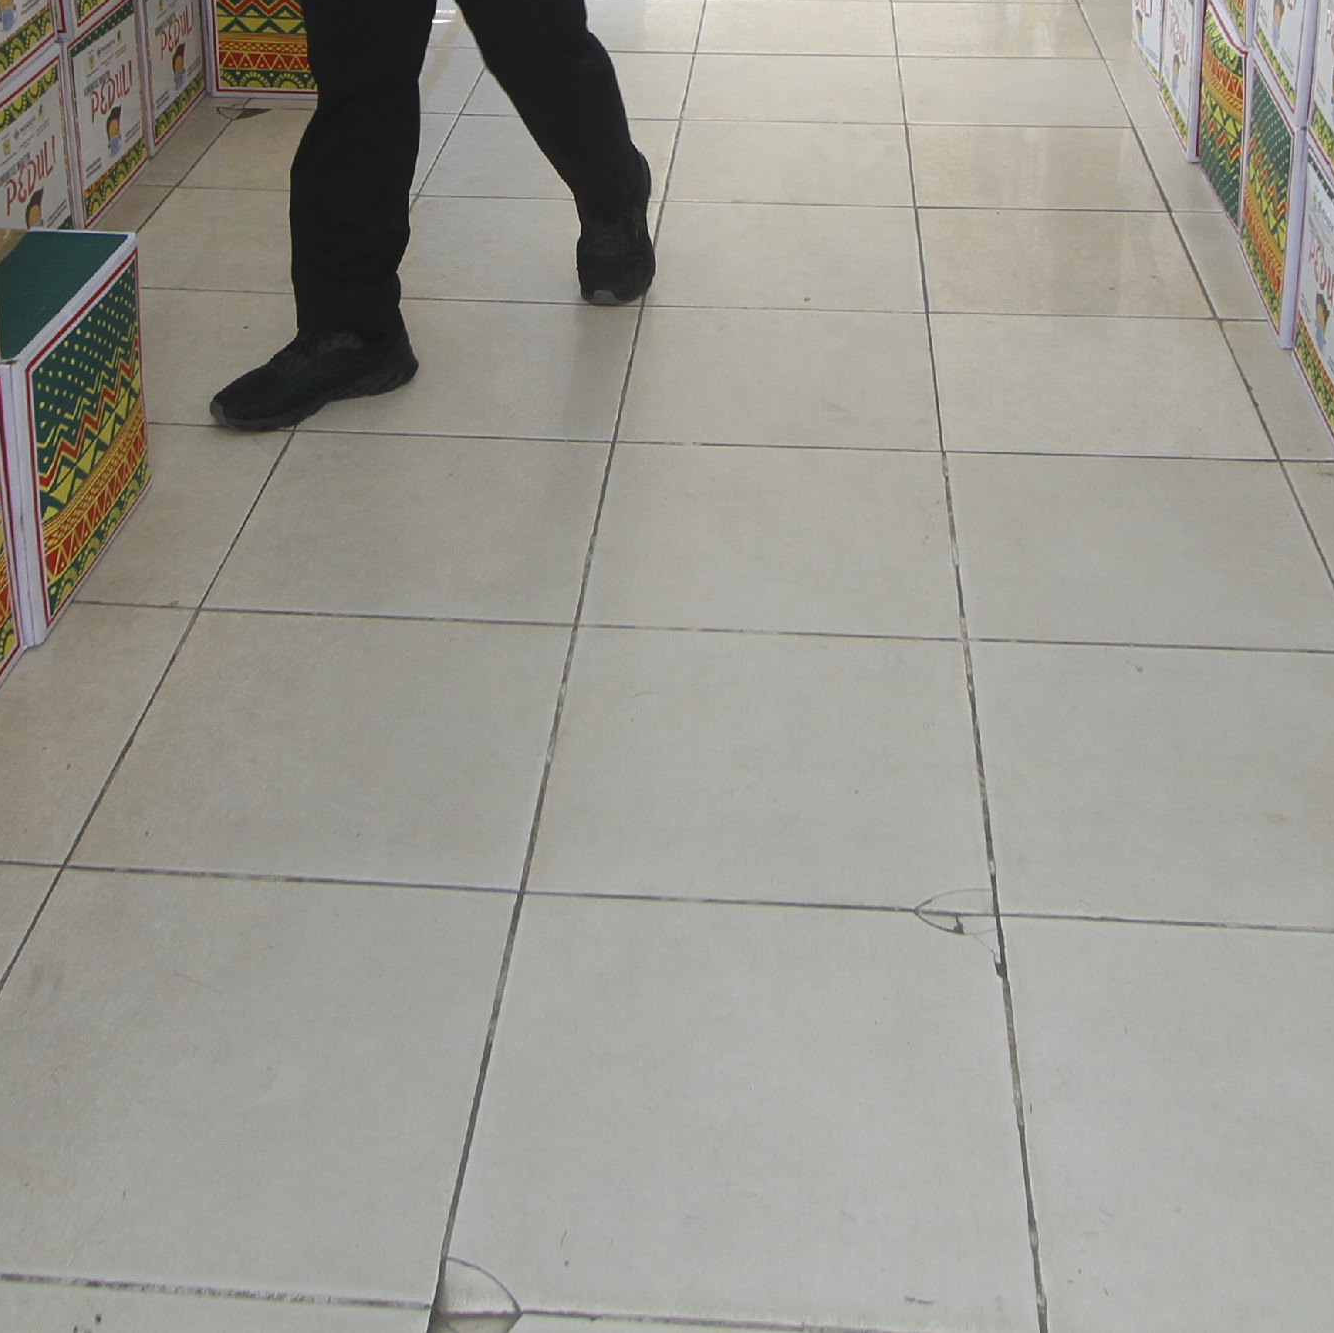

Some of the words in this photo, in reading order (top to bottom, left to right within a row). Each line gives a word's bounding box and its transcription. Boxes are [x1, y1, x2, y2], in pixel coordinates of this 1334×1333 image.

[160, 1, 195, 60] PEDULI
[91, 60, 133, 124] PEDULI
[3, 135, 57, 217] PEDULI
